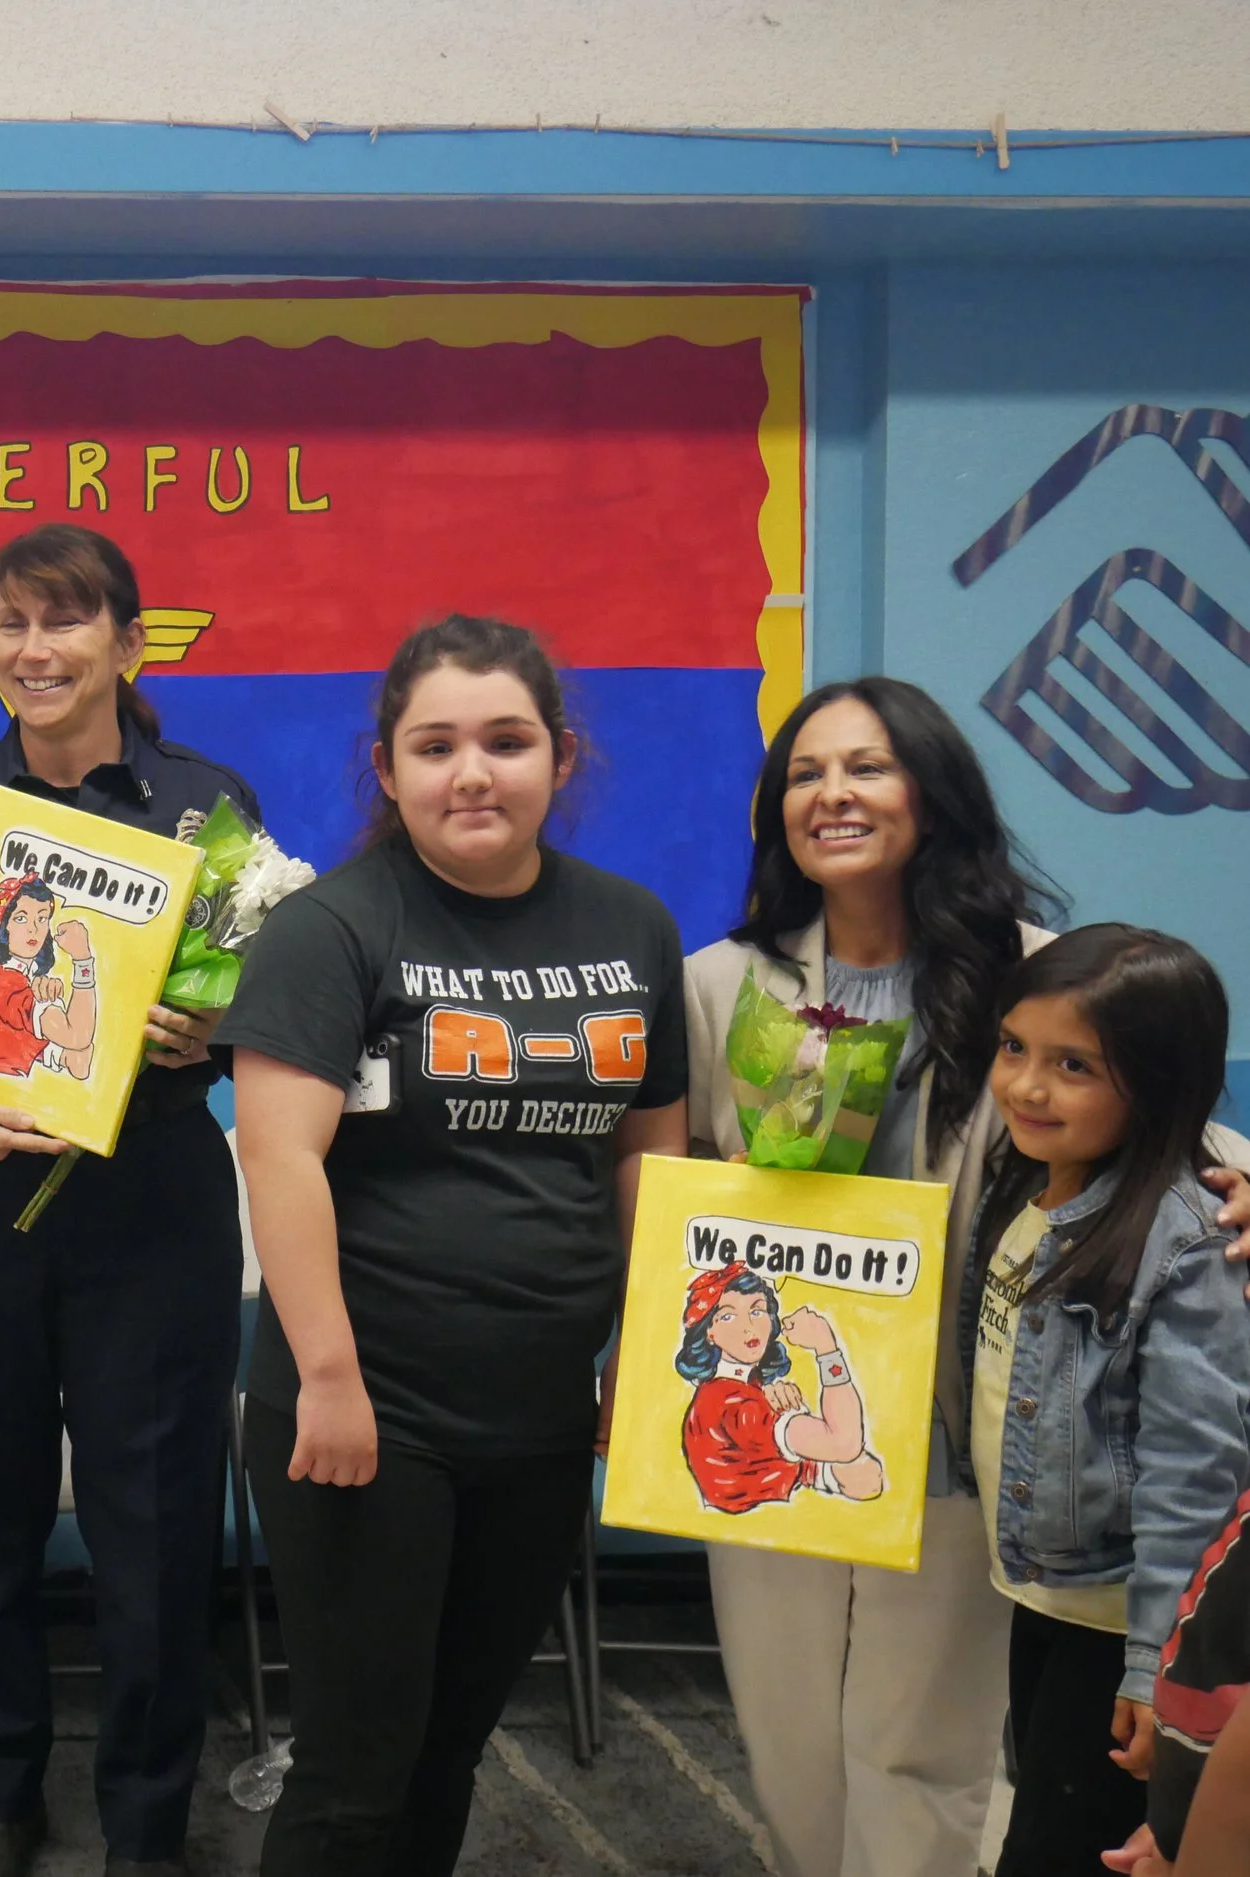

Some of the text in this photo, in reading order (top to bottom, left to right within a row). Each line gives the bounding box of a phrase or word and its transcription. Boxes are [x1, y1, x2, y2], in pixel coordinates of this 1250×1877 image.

[5, 840, 37, 873] We
[43, 855, 87, 891] Can
[93, 868, 119, 902] Do
[401, 961, 483, 1000] WHAT
[492, 969, 533, 1001] TO
[537, 966, 577, 999] DO
[445, 1099, 510, 1131] YOU
[693, 1226, 738, 1264] We
[745, 1235, 804, 1273] Can
[813, 1243, 851, 1280] Do
[980, 1293, 1009, 1335] Fitch
